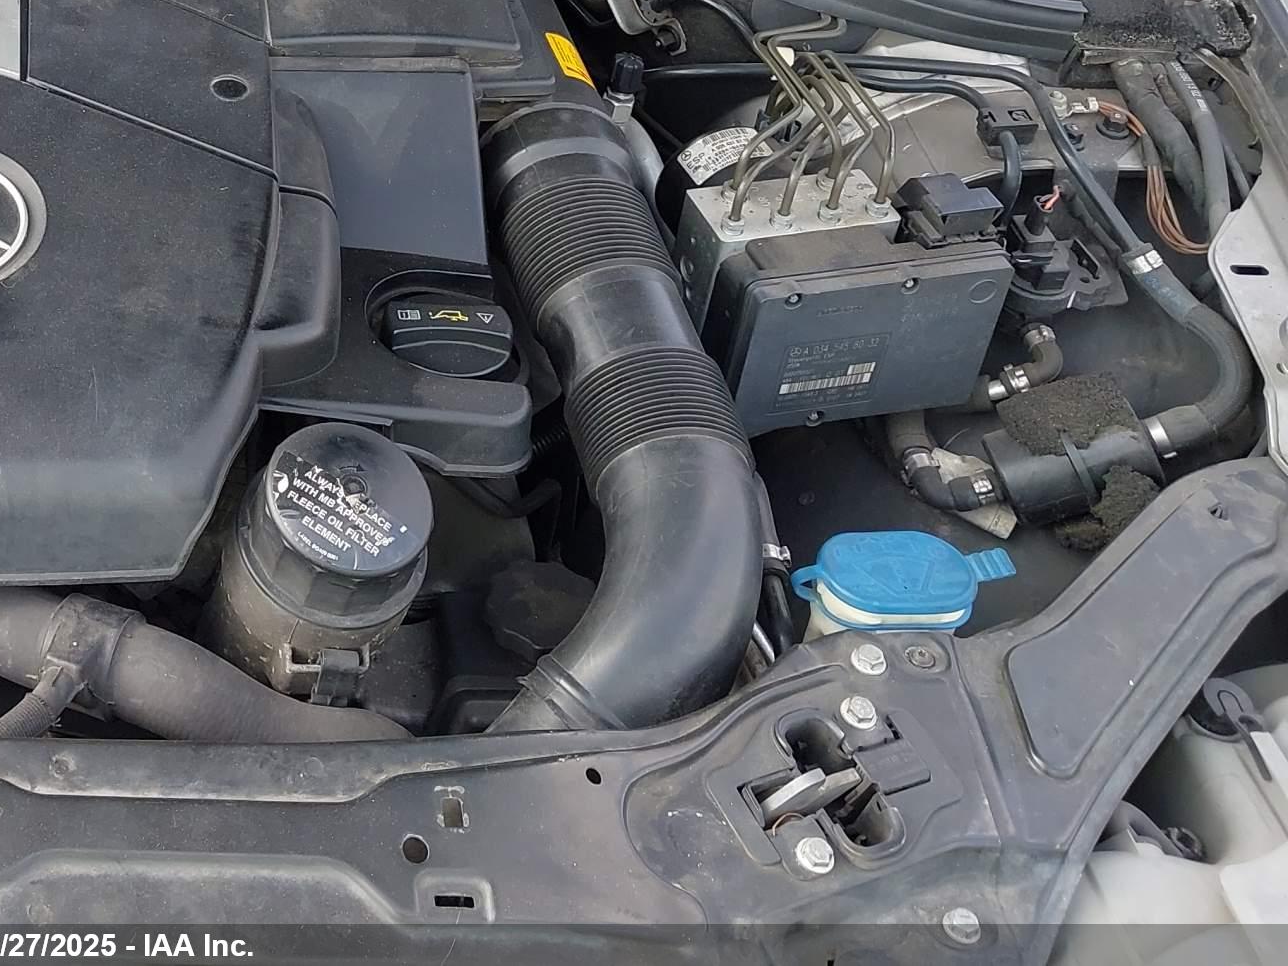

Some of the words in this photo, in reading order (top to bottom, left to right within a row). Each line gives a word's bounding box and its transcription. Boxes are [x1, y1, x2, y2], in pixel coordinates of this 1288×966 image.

[687, 152, 706, 170] ESP
[293, 477, 319, 498] WITH
[318, 493, 336, 508] MB
[304, 470, 344, 498] ALWAYS
[287, 490, 328, 520] FLEECE
[327, 515, 344, 532] OIL
[345, 527, 380, 557] FILTER
[302, 515, 352, 552] ELEMENT
